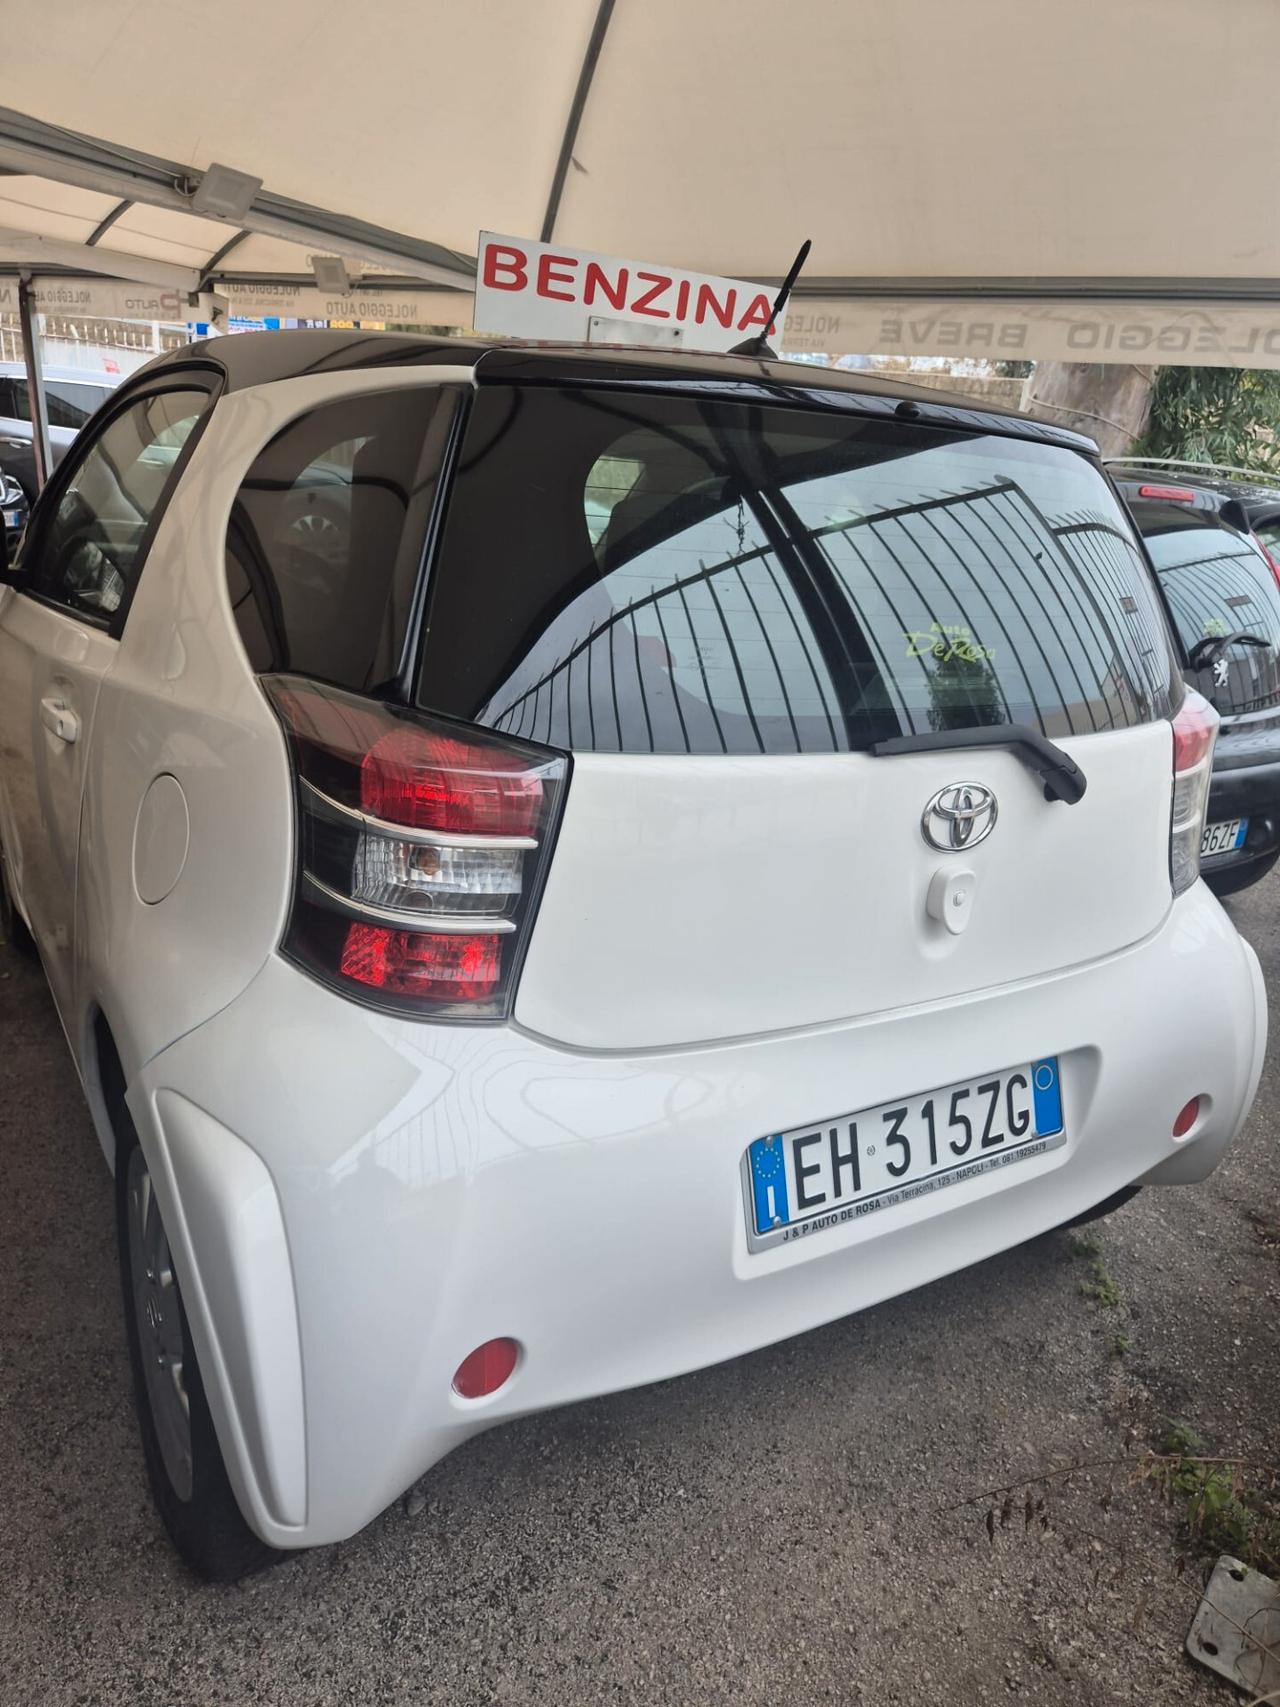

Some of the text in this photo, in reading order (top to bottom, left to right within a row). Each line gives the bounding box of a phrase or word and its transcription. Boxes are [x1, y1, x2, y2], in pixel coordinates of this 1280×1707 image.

[483, 243, 776, 336] BENZINA
[1200, 820, 1240, 853] 86ZF
[792, 1122, 862, 1211] EH
[882, 1073, 1031, 1177] 315ZG
[783, 1230, 789, 1241] J
[792, 1227, 800, 1238] &
[802, 1224, 809, 1234] P
[811, 1213, 838, 1231] AUTO
[841, 1209, 853, 1221] DE
[855, 1200, 881, 1216] ROSA
[887, 1194, 900, 1205] Via
[901, 1183, 935, 1200] Terracina,
[938, 1175, 950, 1188] 125
[956, 1164, 984, 1180] NAPOLI
[989, 1158, 1001, 1169] Tel.
